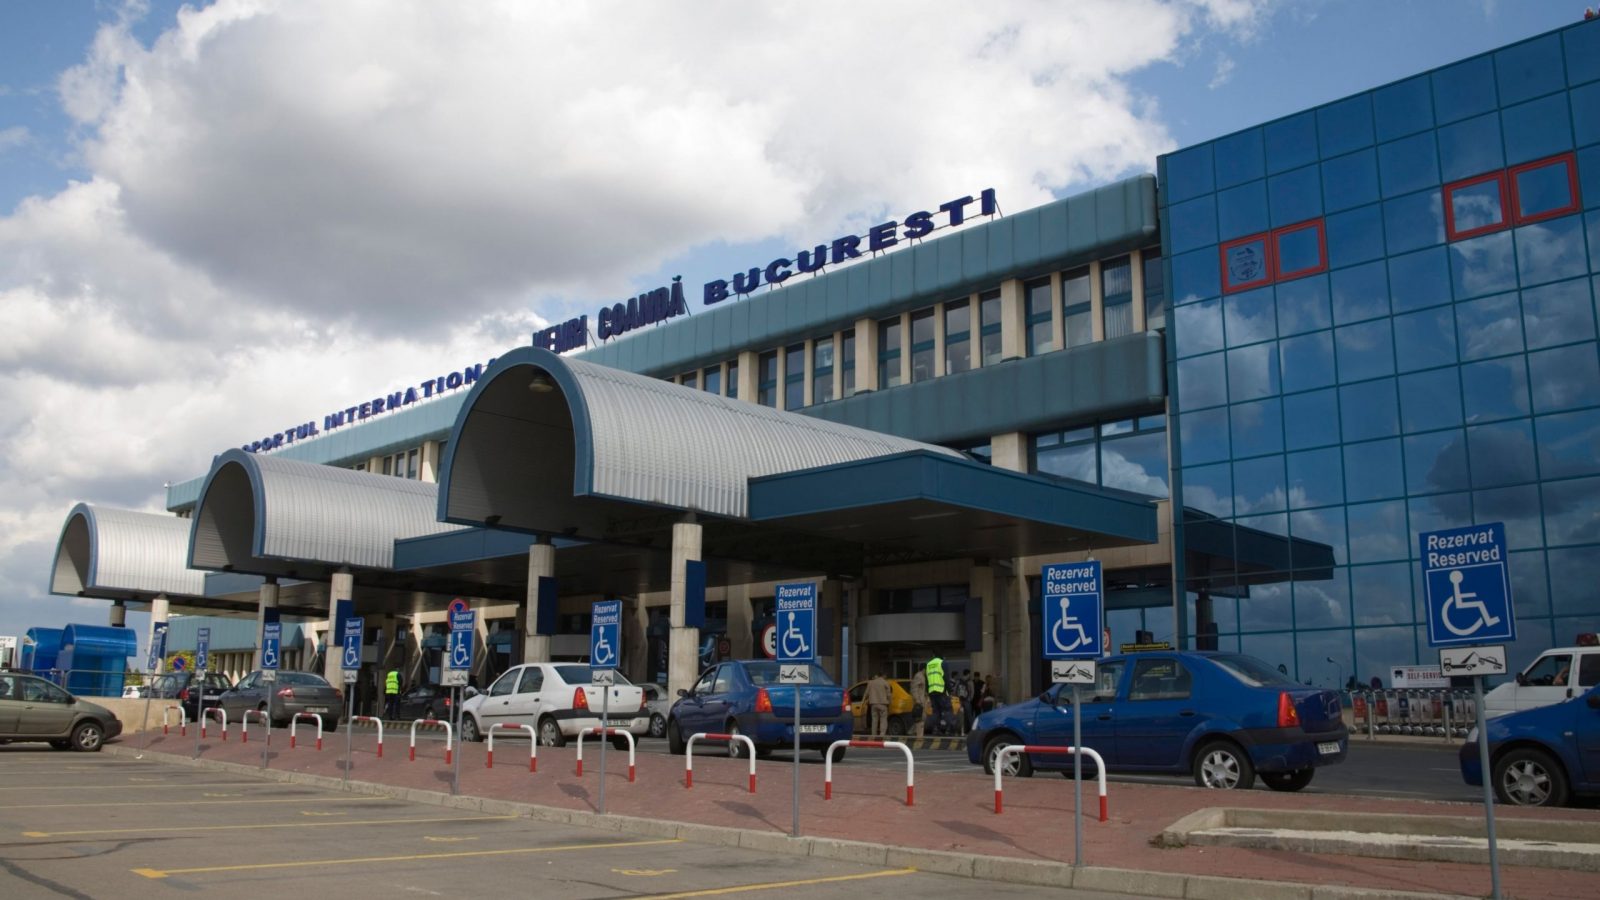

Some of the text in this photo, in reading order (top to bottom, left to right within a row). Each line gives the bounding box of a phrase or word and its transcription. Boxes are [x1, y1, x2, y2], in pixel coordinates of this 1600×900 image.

[324, 358, 496, 431] INTERNATION
[704, 187, 996, 305] BUCURESTI
[1428, 528, 1494, 551] Rezervat
[1428, 544, 1501, 568] Reserved
[1047, 565, 1094, 580] Rezervat
[779, 586, 812, 598] Rezervat
[1047, 578, 1097, 594] Reserved
[779, 597, 813, 609] Reserved
[593, 612, 619, 624] Reserved
